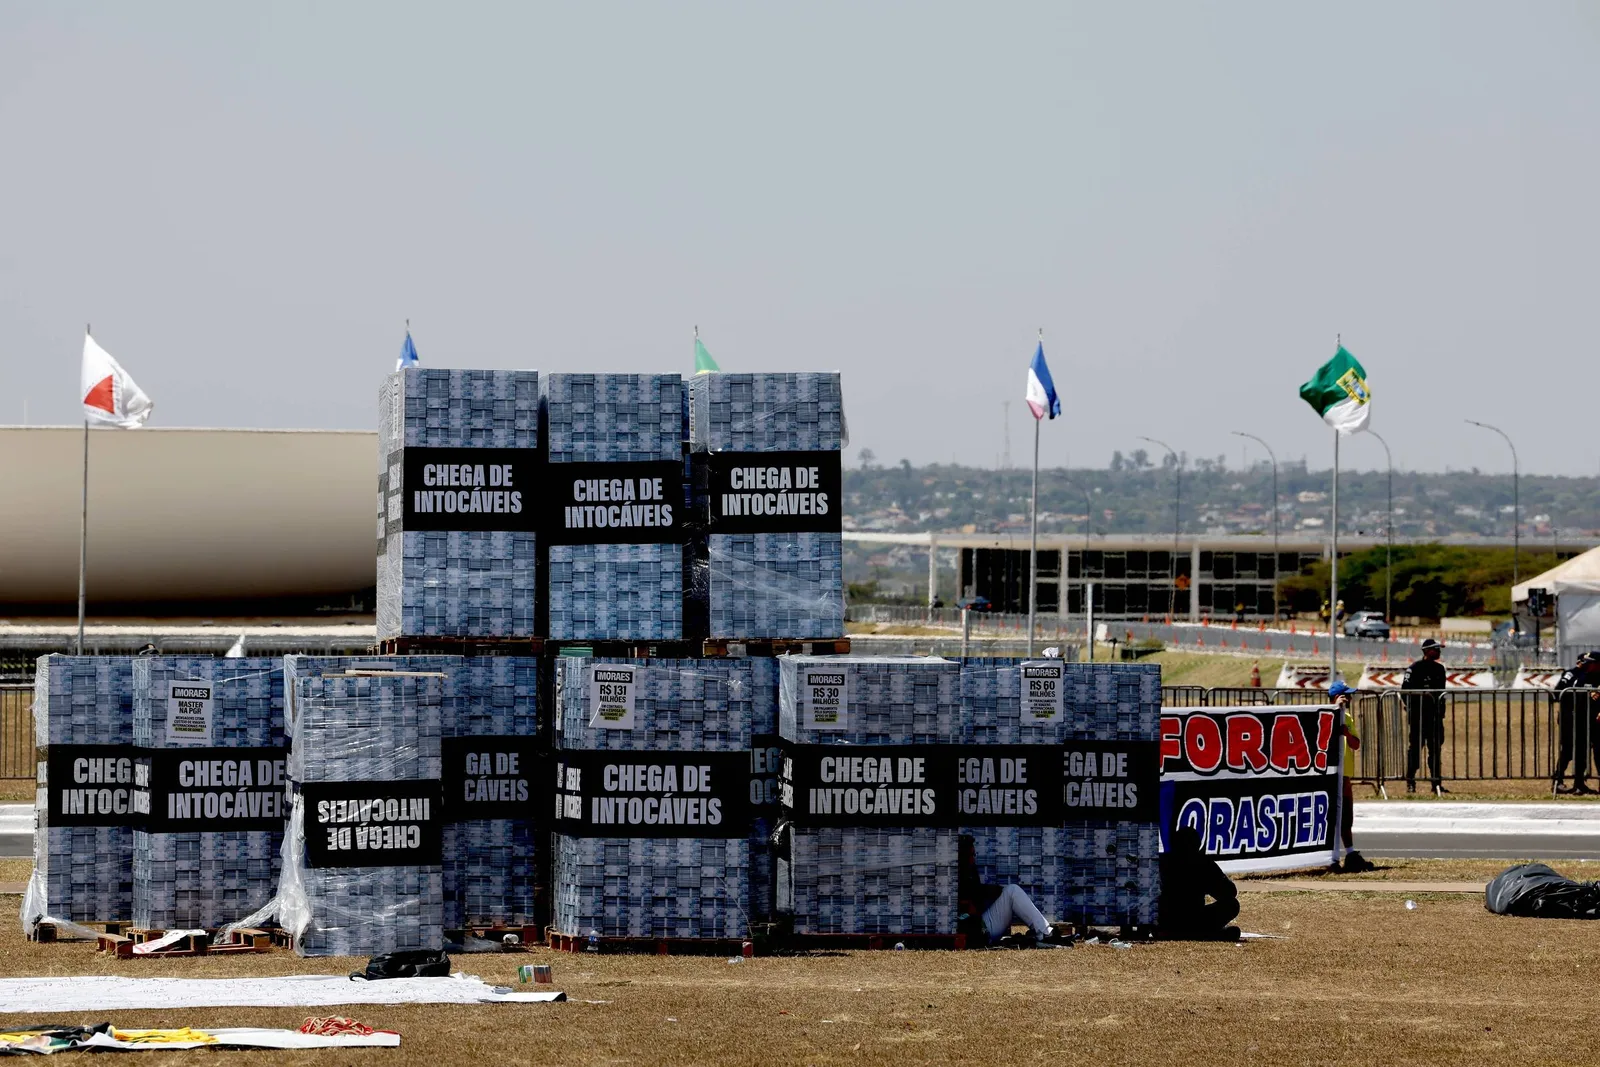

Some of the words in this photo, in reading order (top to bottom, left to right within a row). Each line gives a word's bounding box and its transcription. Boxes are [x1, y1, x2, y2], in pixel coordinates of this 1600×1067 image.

[424, 464, 485, 487] CHEGA
[490, 464, 513, 487] DE
[731, 467, 791, 489] CHEGA
[796, 467, 819, 489] DE
[414, 487, 522, 513] INTOCÁVEIS
[573, 479, 635, 501] CHEGA
[640, 478, 663, 501] DE
[722, 489, 828, 515] INTOCÁVEIS
[565, 501, 673, 528] INTOCÁVEIS
[597, 671, 630, 681] iMORAES
[810, 675, 843, 684] iMORAES
[1030, 680, 1041, 690] R$
[1043, 681, 1055, 690] 60
[600, 684, 612, 695] R$
[614, 685, 627, 696] 131
[600, 695, 627, 703] MILHÕES
[813, 687, 825, 698] R$
[827, 687, 839, 698] 30
[1160, 709, 1335, 772] FORA!
[74, 757, 133, 784] CHEG
[179, 760, 253, 786] CHEGA
[257, 760, 286, 786] DE
[496, 753, 519, 775] DE
[820, 757, 893, 783] CHEGA
[898, 757, 925, 783] DE
[1000, 758, 1027, 784] DE
[1102, 752, 1128, 777] DE
[604, 765, 678, 792] CHEGA
[683, 765, 711, 792] DE
[809, 784, 936, 815] INTOCÁVEIS
[1063, 777, 1138, 808] CÁVEIS
[317, 798, 430, 827] INTOCÁVEIS
[592, 793, 722, 825] INTOCÁVEIS
[327, 827, 352, 851] DE
[356, 825, 421, 850] CHEGA
